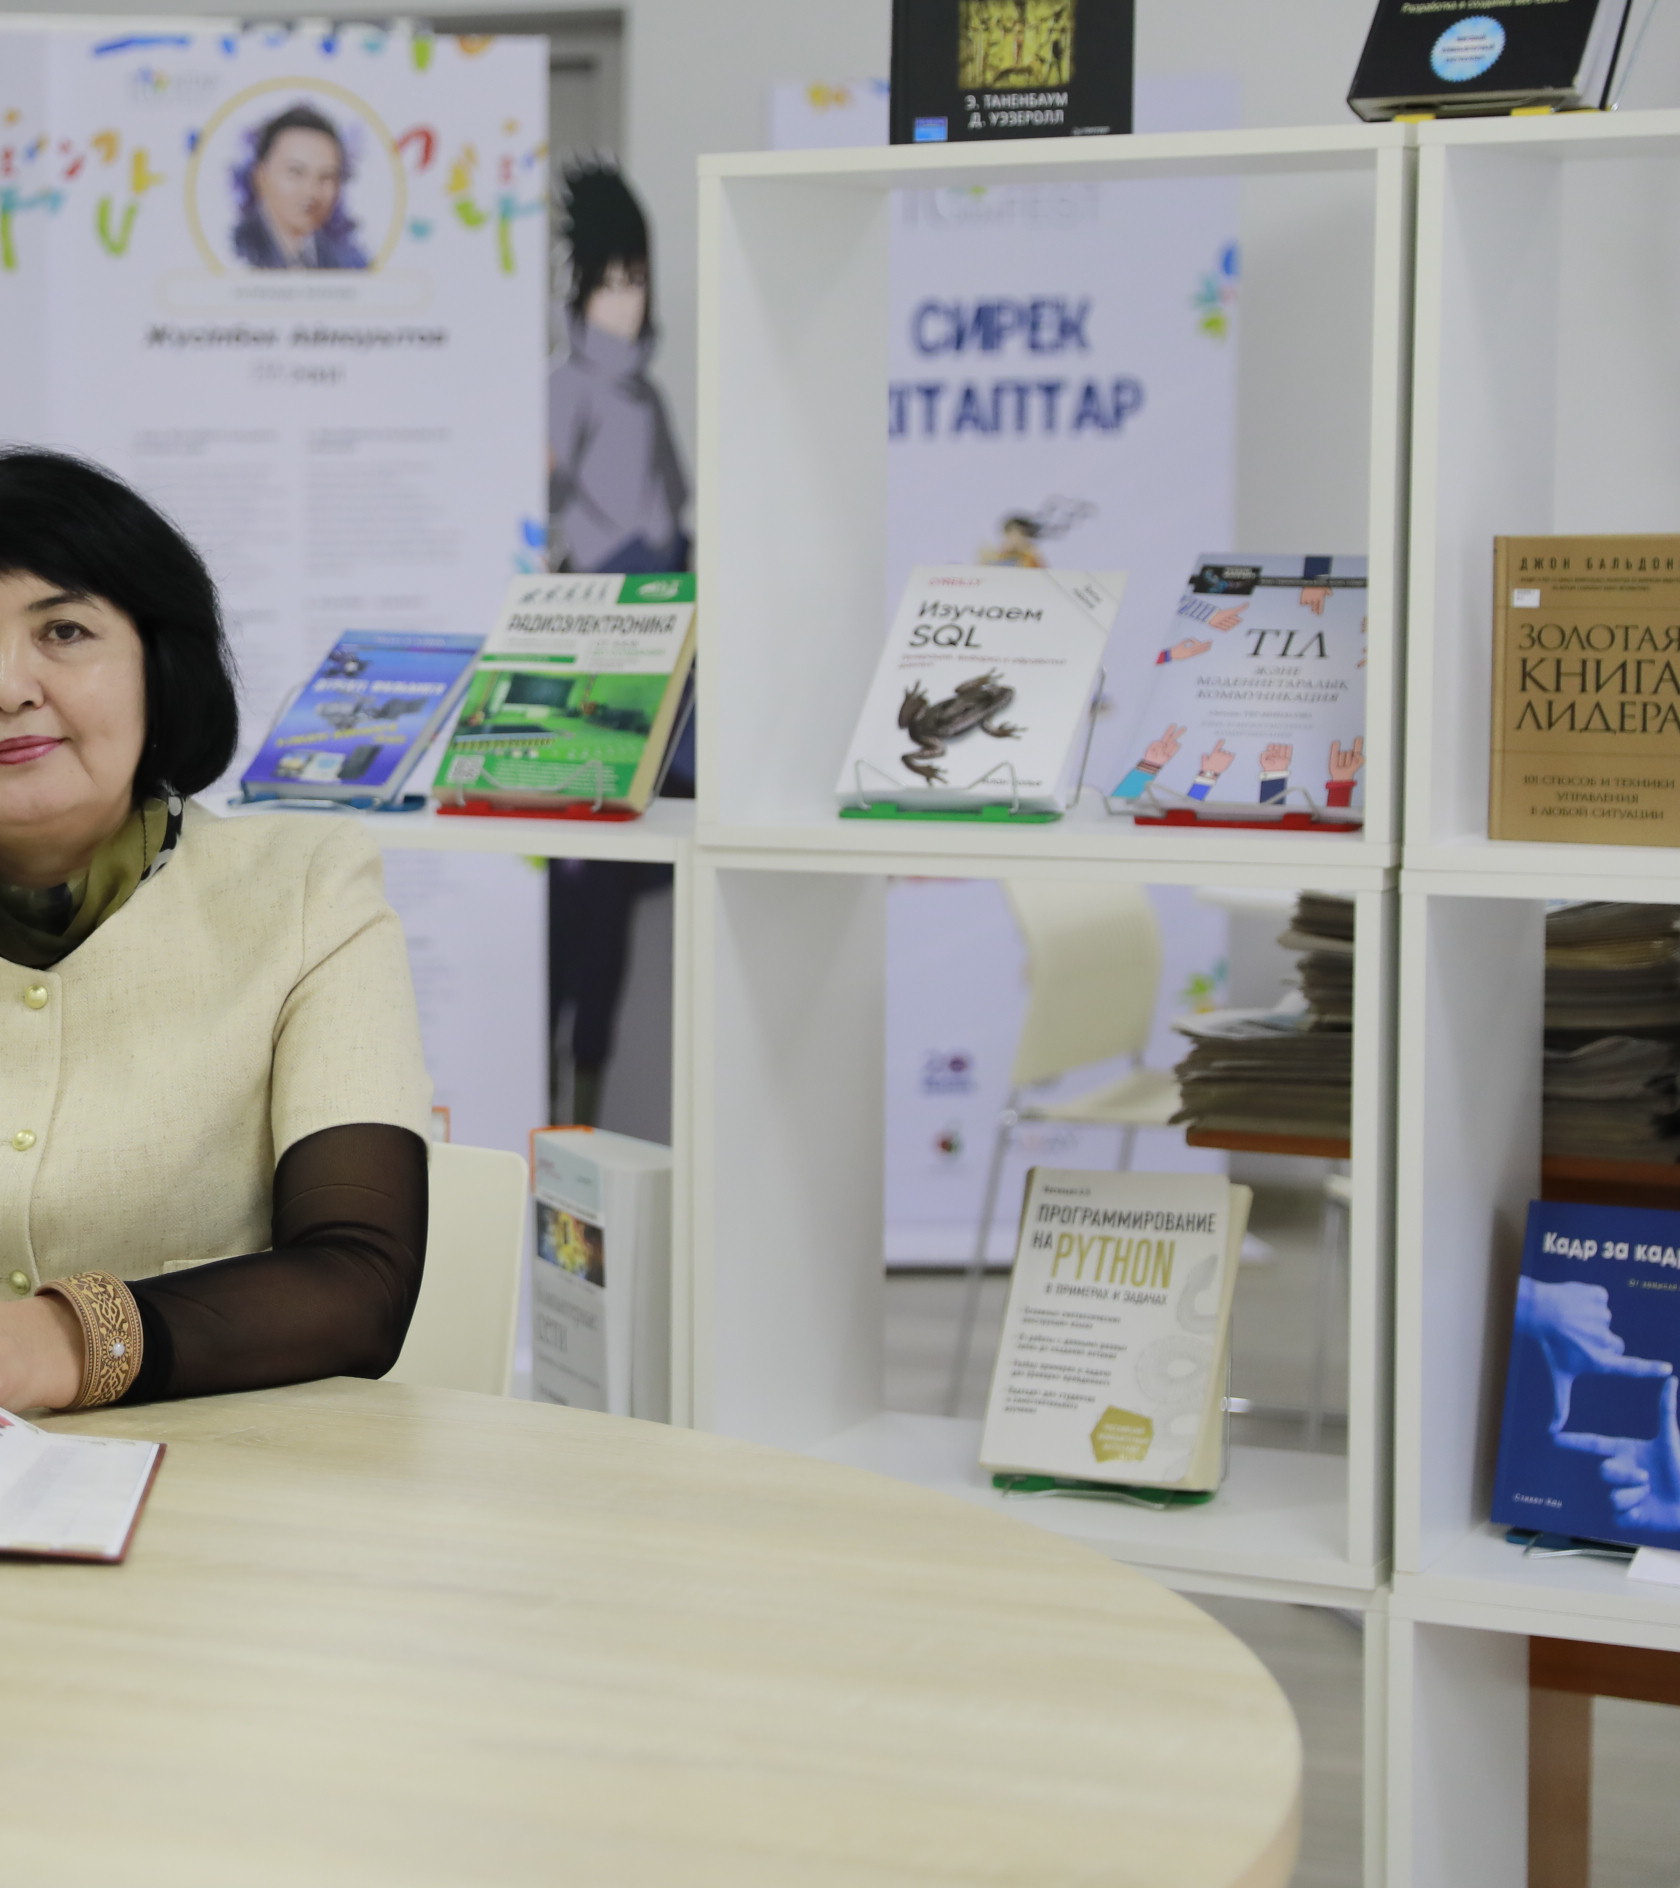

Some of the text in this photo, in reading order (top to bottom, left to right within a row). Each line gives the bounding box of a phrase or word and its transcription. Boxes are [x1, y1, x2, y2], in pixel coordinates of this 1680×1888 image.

[964, 92, 1068, 110] Э. ТАНЕНБАУМ
[968, 112, 986, 129] Д.
[989, 109, 1064, 127] УЭЗЕРОЛЛ
[912, 297, 1092, 356] СИРЕК
[888, 377, 1145, 438] ІТАПТАР
[1519, 556, 1680, 572] ДЖОН БАЛЬДОН
[918, 600, 1044, 622] Изучаем
[508, 613, 677, 635] РАДИОЭЛЕКТРОНИКА
[909, 624, 982, 649] SQL
[1519, 623, 1680, 652] ЗОЛОТАЯ
[1520, 657, 1680, 694] КНИГА
[1516, 700, 1680, 735] ЛИДЕРА
[1541, 775, 1597, 787] СПОСОБ
[1614, 777, 1675, 790] ТЕХНИКИ
[1556, 791, 1639, 804] УПРАВЛЕНИЯ
[1592, 807, 1665, 820] СИТУАЦИИ
[1037, 1202, 1217, 1234] ПРОГРАММИРОВАНИЕ
[1031, 1230, 1176, 1289] НА PYTHON
[1542, 1231, 1680, 1270] Кадр за кад
[1055, 1284, 1110, 1300] ПРИМЕРАХ
[1123, 1289, 1168, 1306] ЗАДАЧАХ
